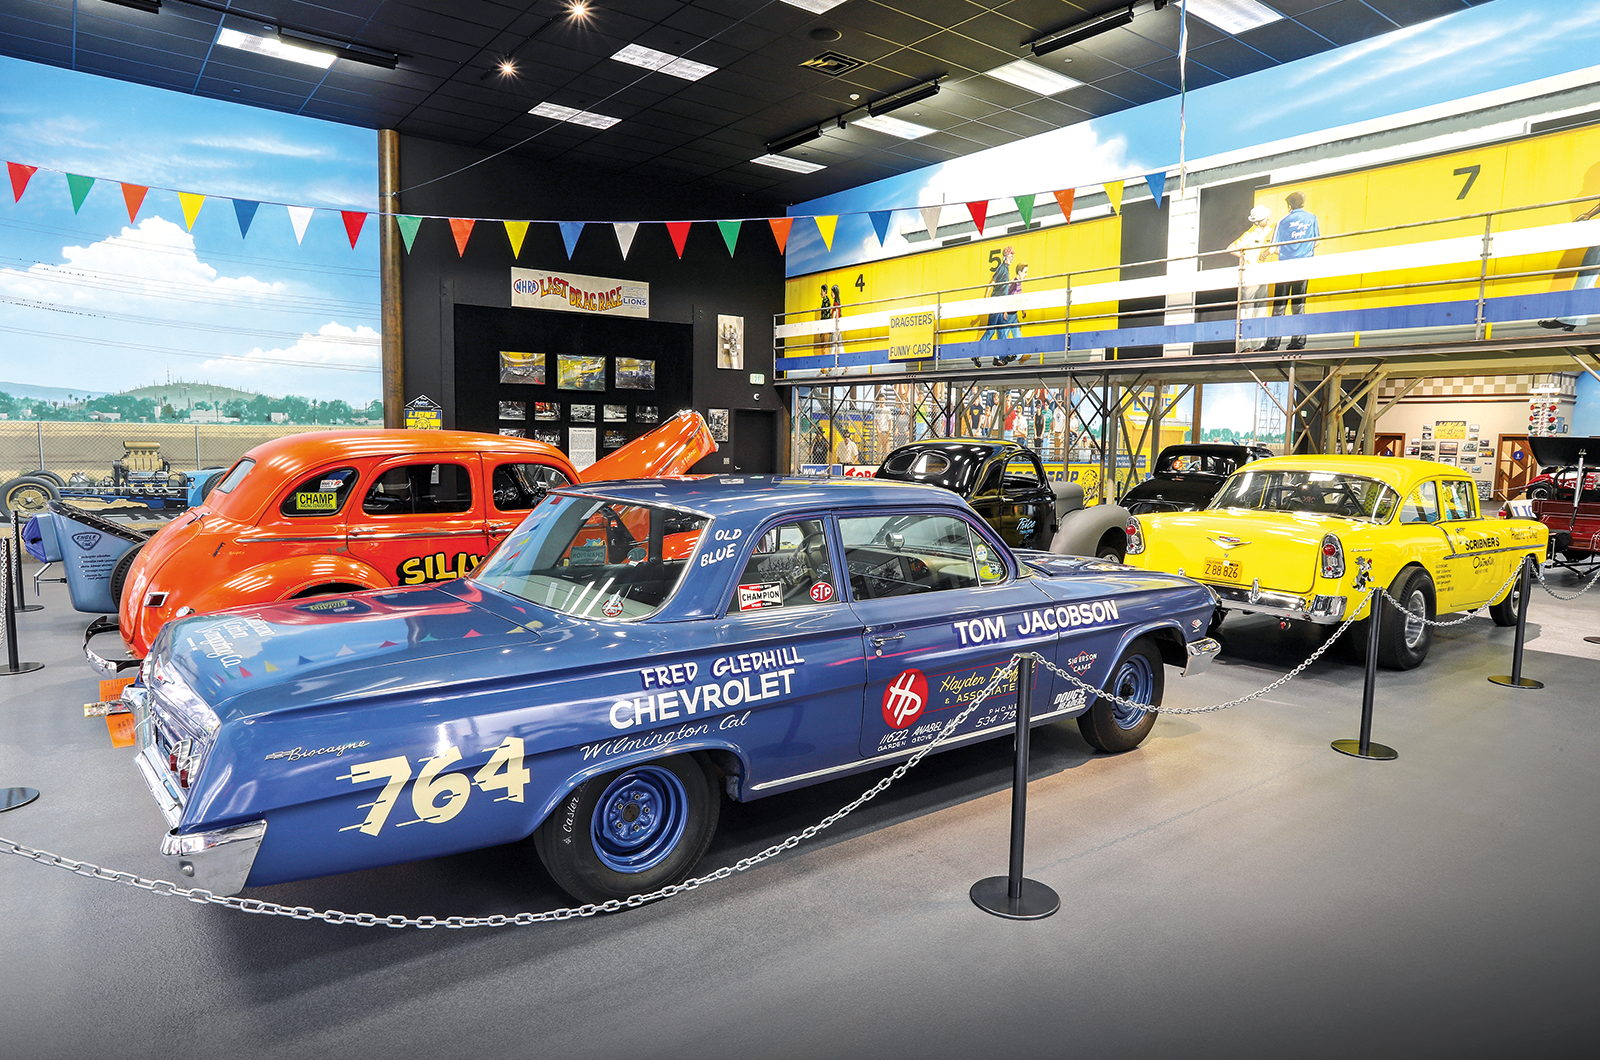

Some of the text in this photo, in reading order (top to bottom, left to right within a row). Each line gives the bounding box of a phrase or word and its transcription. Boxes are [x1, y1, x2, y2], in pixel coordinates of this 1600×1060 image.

[1453, 164, 1481, 200] 7
[988, 249, 1001, 272] 5
[855, 274, 865, 292] 4
[515, 277, 622, 311] NHRA LAST DRAG RACE
[623, 298, 647, 306] LIONS
[890, 313, 933, 328] DRAGSTER'S
[890, 343, 932, 357] FUNNY CARS
[300, 493, 334, 505] CHAMP
[715, 528, 742, 541] OLD
[1465, 537, 1500, 551] SCRIBNER'S
[700, 543, 737, 567] BLUE
[1205, 563, 1238, 578] Z 88 826
[741, 590, 780, 602] CHAMPION
[812, 584, 831, 601] STP
[953, 600, 1119, 646] TOM JACOBSON
[640, 647, 805, 690] FRED GLEDHILL
[1073, 663, 1092, 673] CAMS
[939, 672, 985, 695] Hayden
[609, 668, 795, 730] CHEVROLET
[956, 683, 1018, 703] ASSOIATE
[1054, 688, 1087, 705] DOUG'S
[1056, 695, 1088, 711] HEADERS
[719, 710, 751, 731] Cal
[879, 729, 909, 745] 11622
[877, 740, 907, 752] GARDEN
[336, 736, 530, 837] 764
